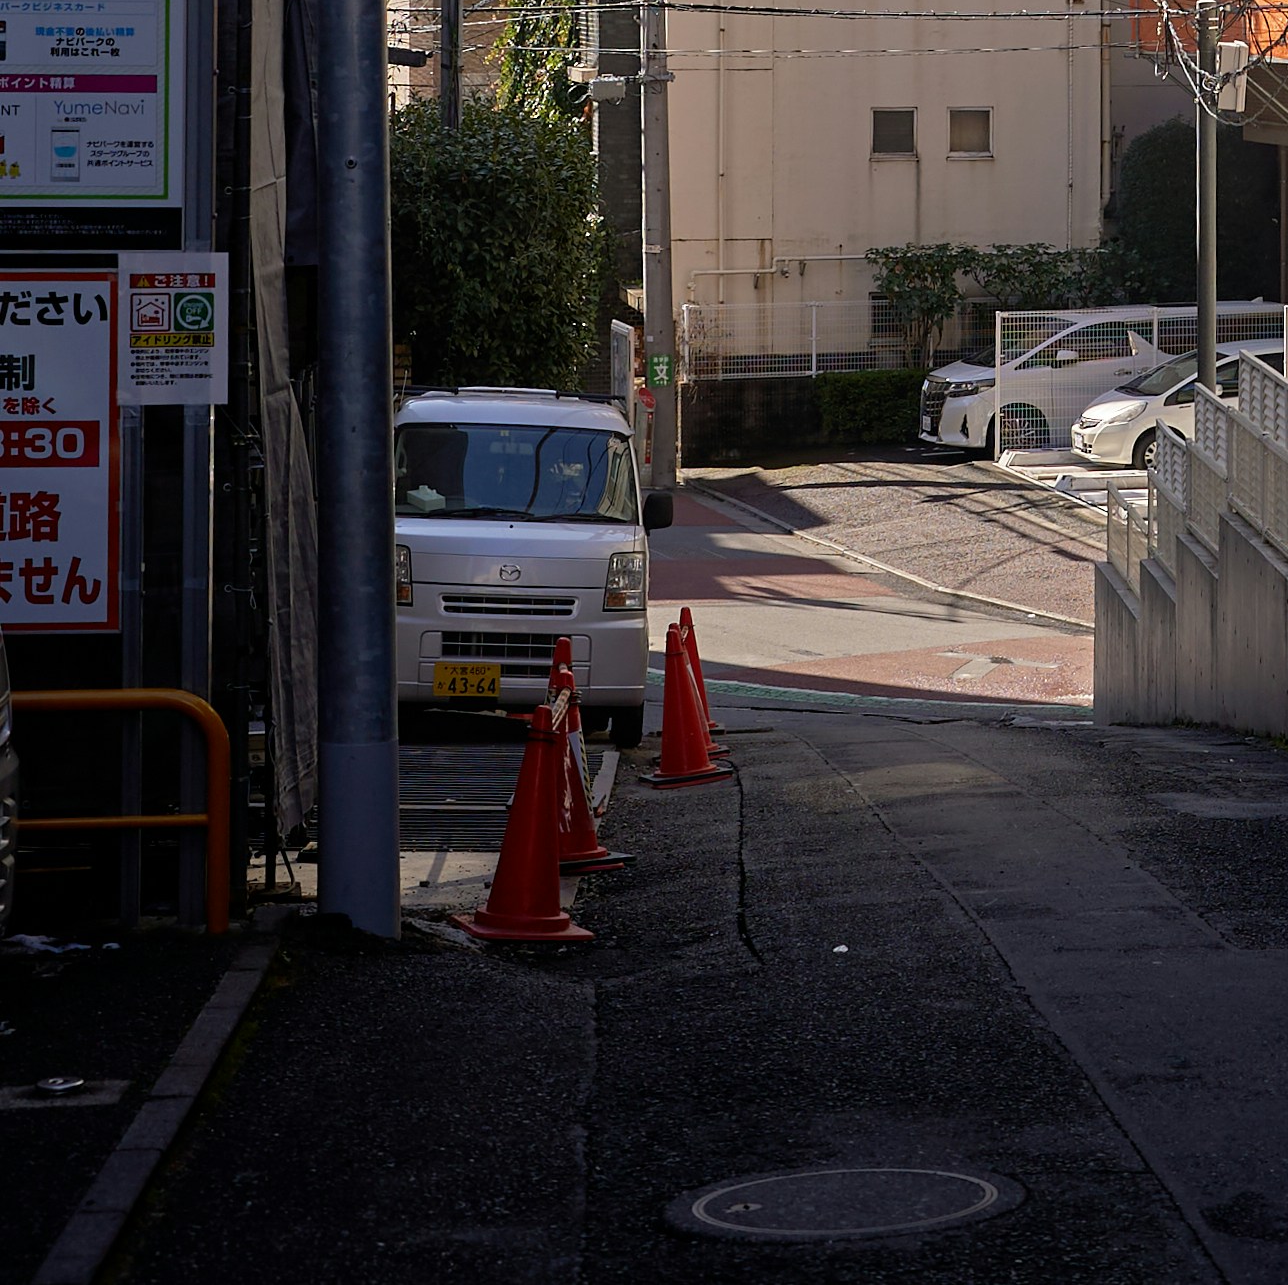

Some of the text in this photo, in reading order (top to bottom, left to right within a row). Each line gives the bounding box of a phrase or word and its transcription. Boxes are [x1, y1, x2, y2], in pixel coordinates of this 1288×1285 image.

[53, 99, 145, 115] YumeNavi
[0, 291, 108, 326] ださい
[653, 363, 669, 381] 文
[3, 396, 57, 416] を除く
[0, 426, 86, 461] :30
[0, 490, 62, 542] 路
[448, 677, 496, 694] 43-64
